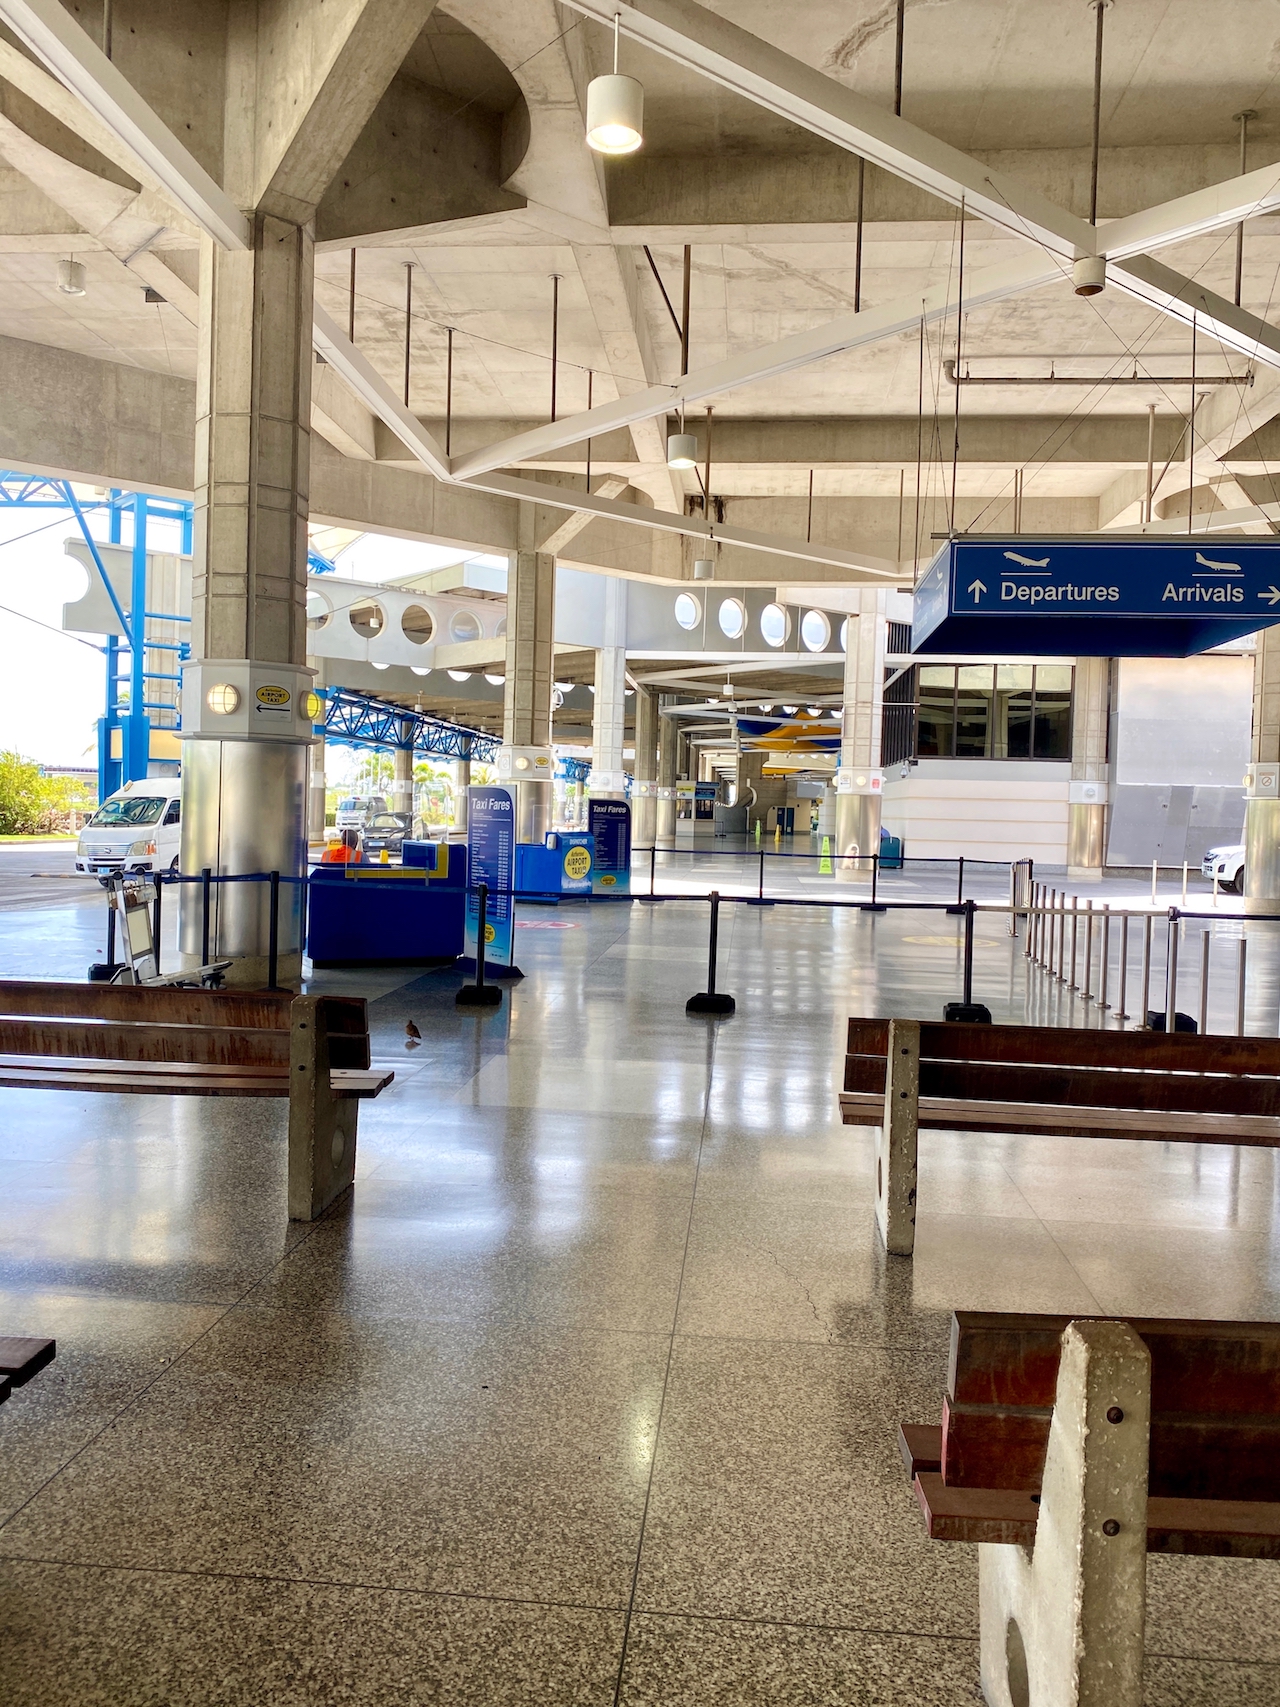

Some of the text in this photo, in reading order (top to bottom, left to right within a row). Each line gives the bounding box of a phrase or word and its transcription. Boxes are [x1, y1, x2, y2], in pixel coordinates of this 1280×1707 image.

[1001, 581, 1120, 605] Departures
[1161, 583, 1244, 603] Arrivals
[472, 797, 511, 811] Taxi Fares
[593, 805, 626, 813] Taxi Fares
[567, 857, 587, 867] AIRPORT
